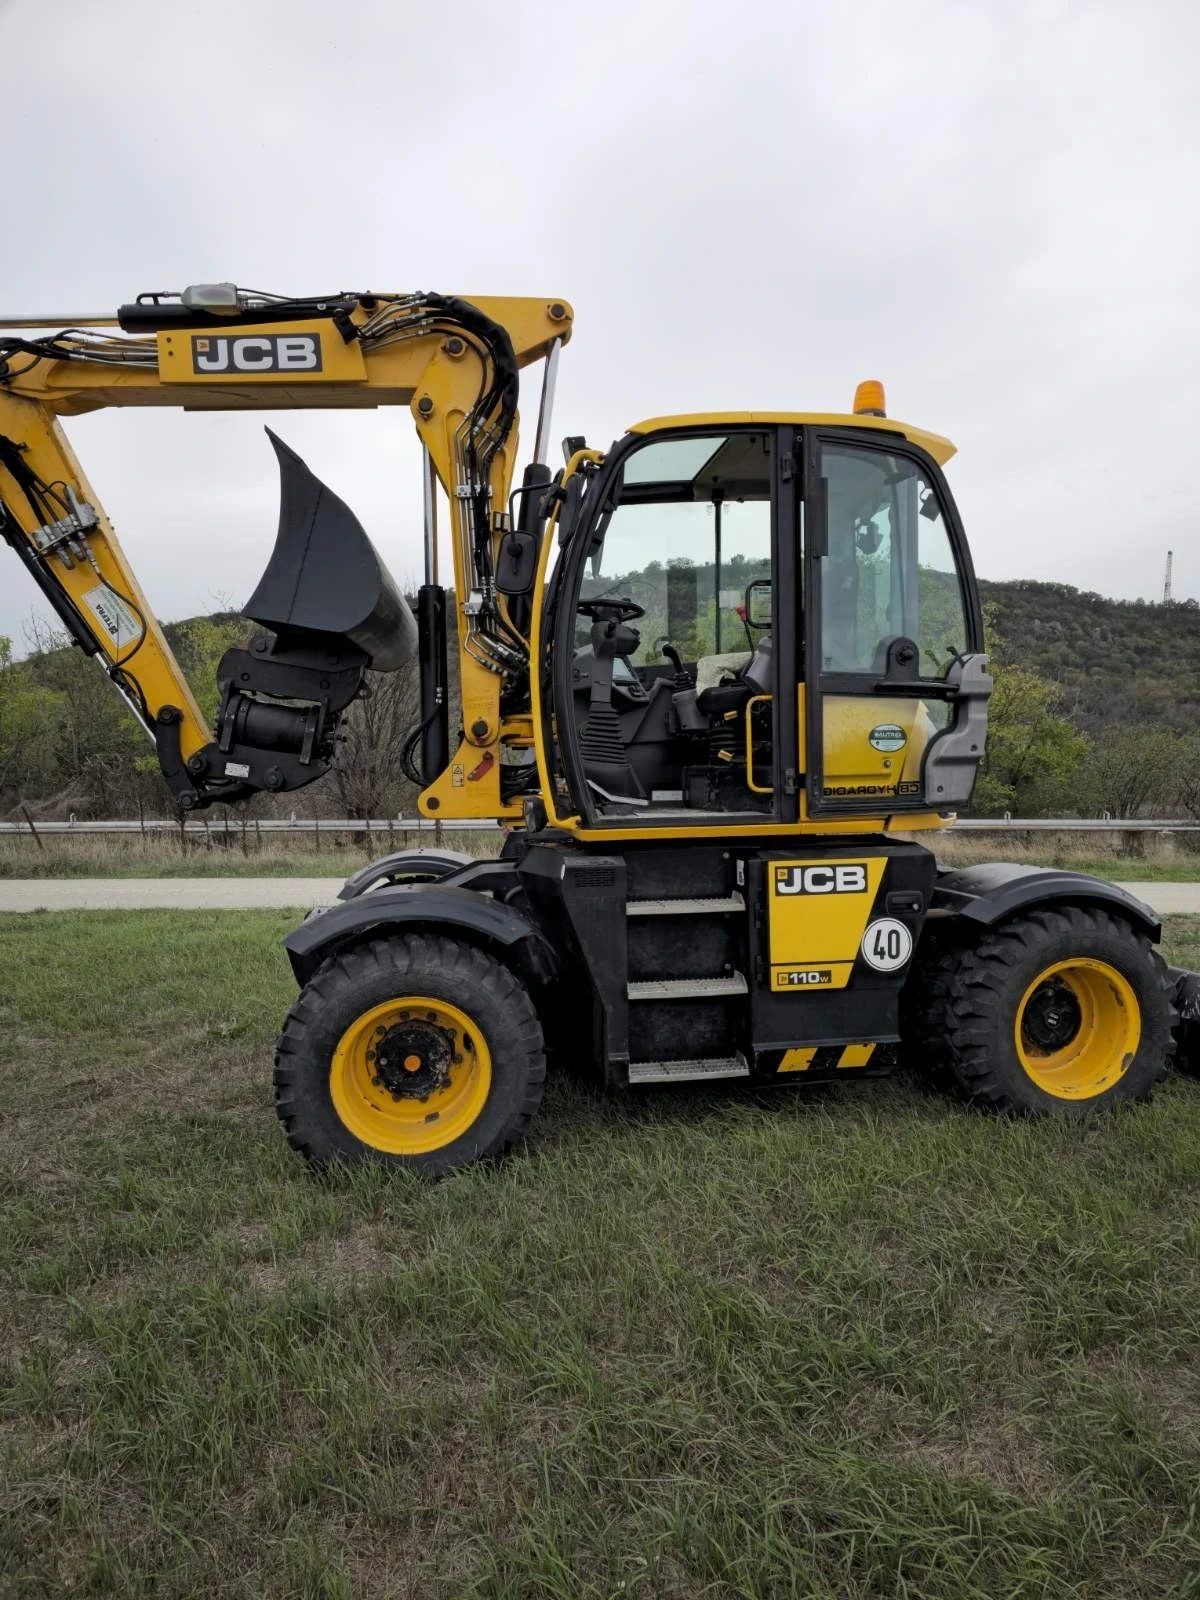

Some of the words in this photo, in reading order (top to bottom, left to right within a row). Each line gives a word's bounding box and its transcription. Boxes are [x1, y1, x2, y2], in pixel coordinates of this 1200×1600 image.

[197, 337, 317, 371] JCB
[777, 866, 866, 894] JCB
[873, 929, 901, 960] 40
